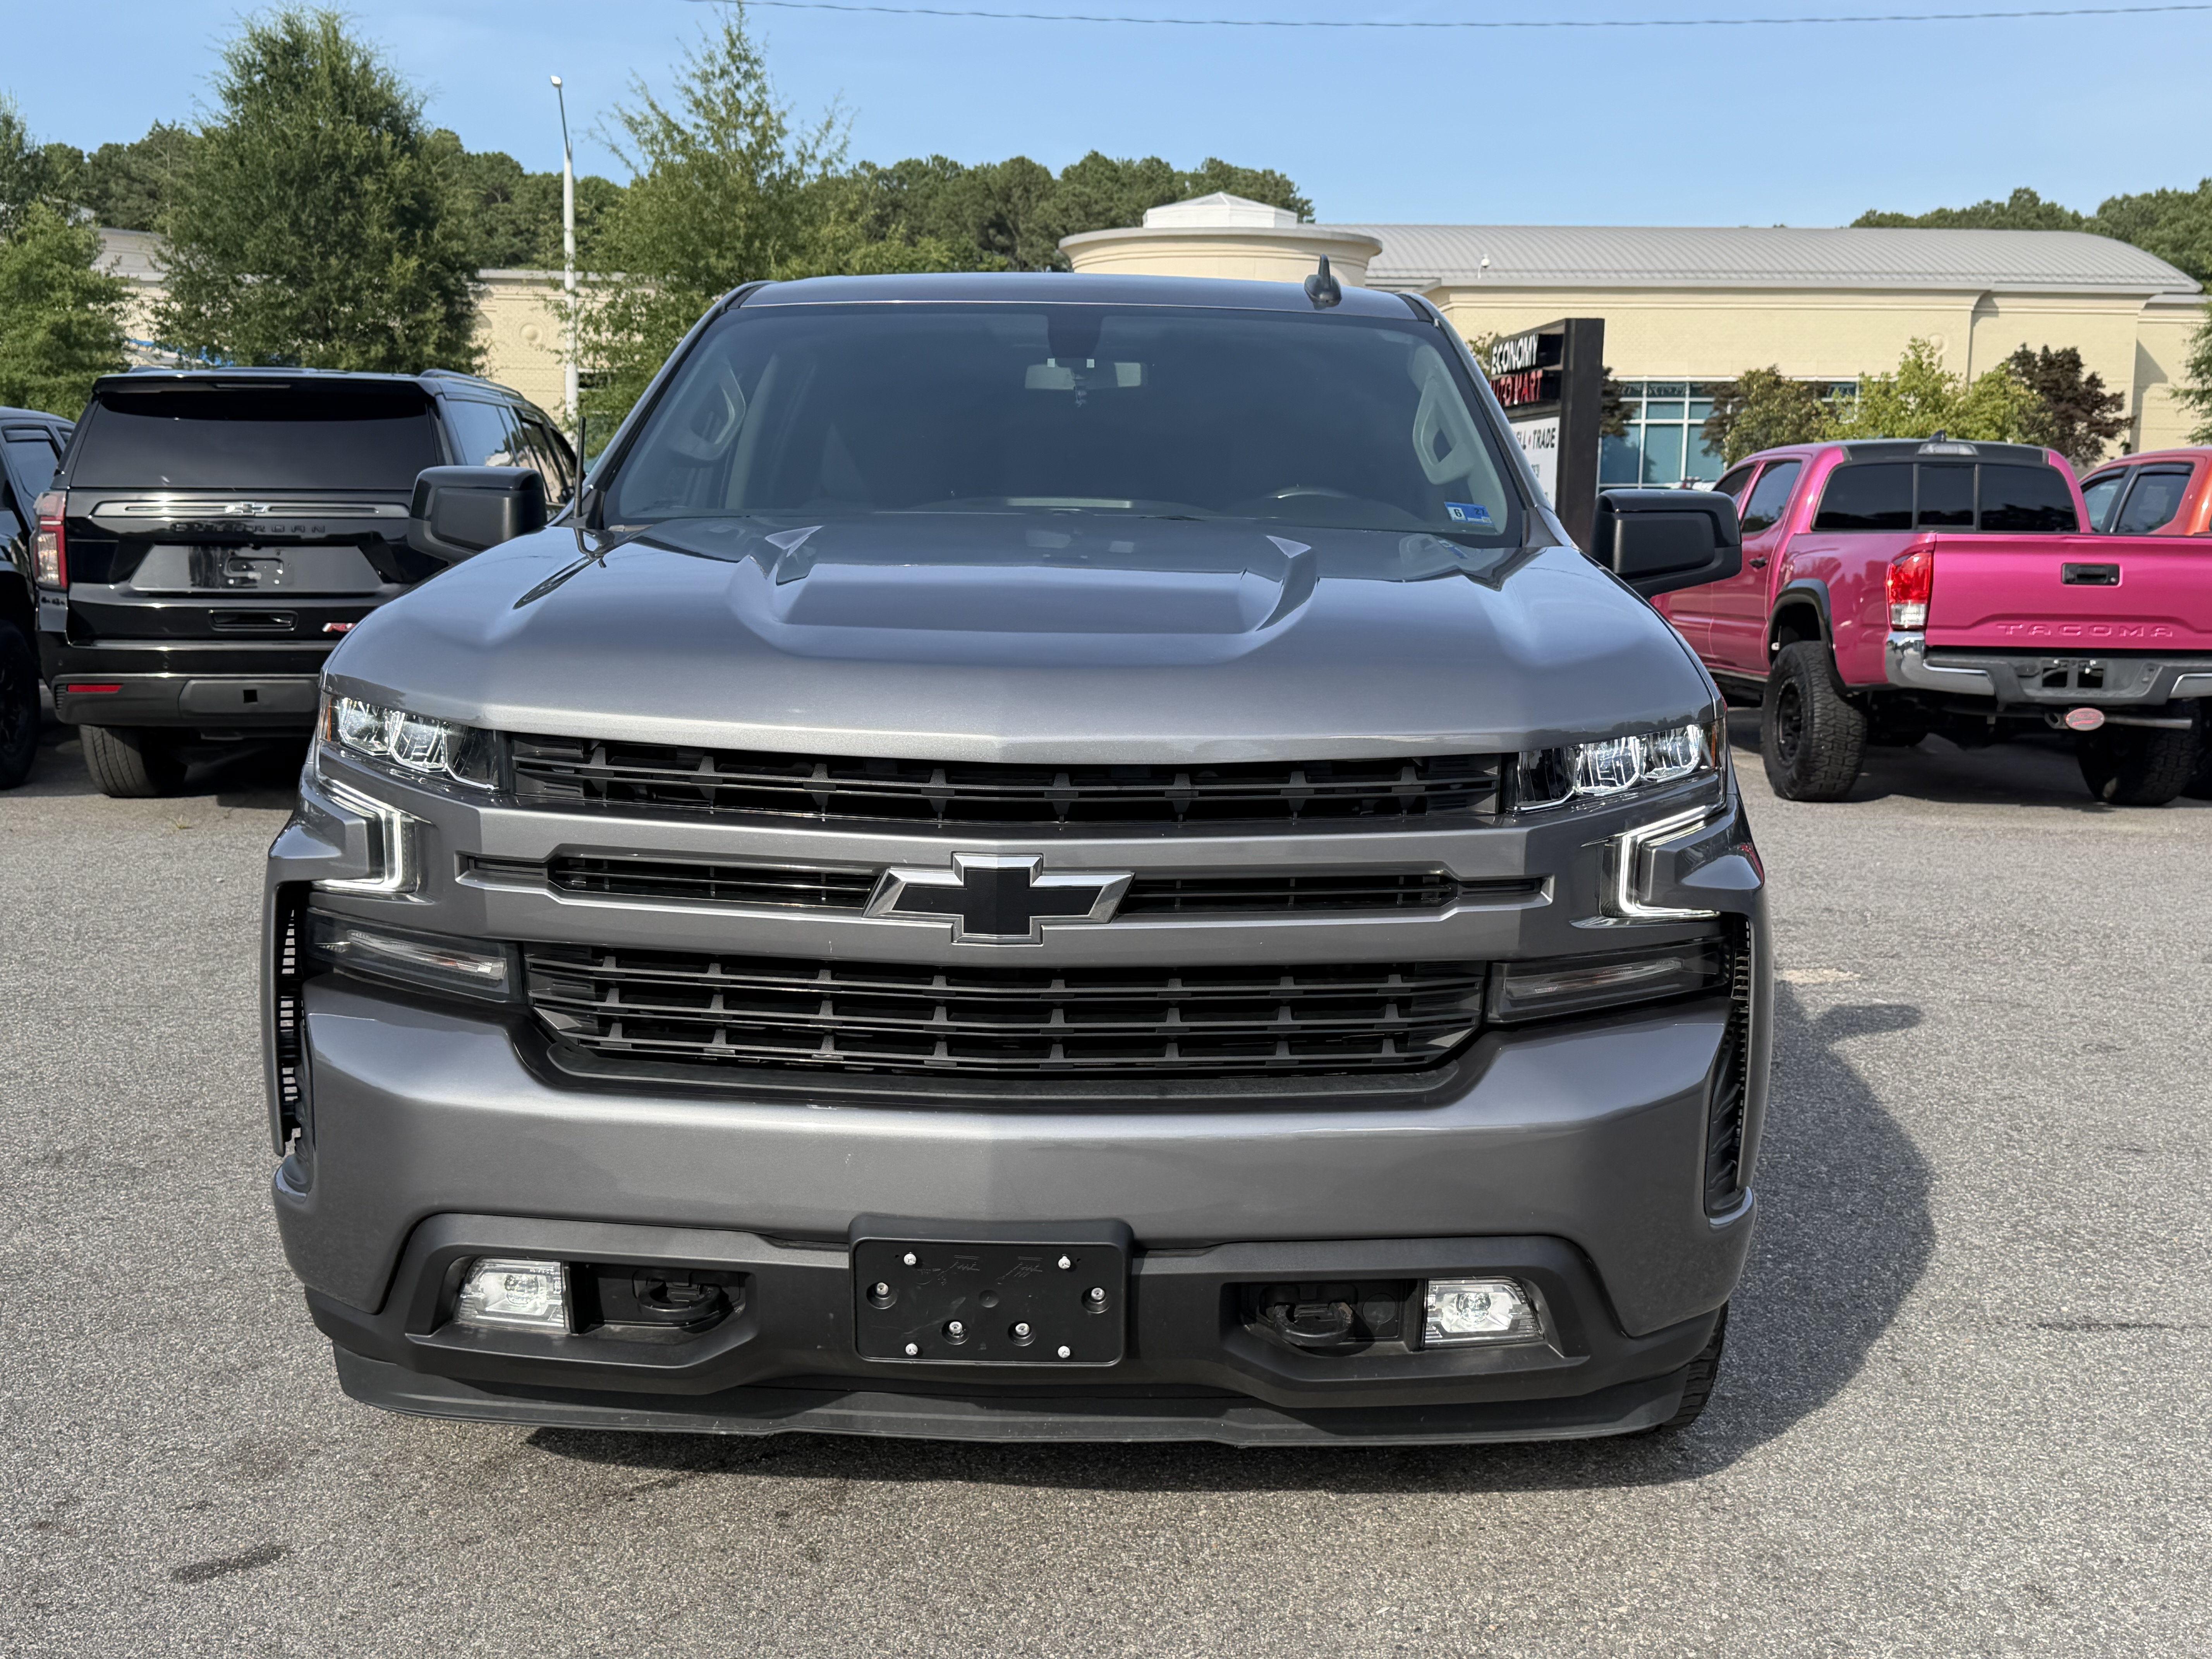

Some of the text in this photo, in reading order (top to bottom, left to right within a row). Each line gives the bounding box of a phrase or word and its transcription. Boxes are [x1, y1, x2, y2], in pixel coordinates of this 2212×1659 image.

[1491, 333, 1539, 375] ECONOMY
[1533, 428, 1556, 449] TRADE
[1454, 508, 1462, 517] 6
[1997, 624, 2173, 637] TACOMA
